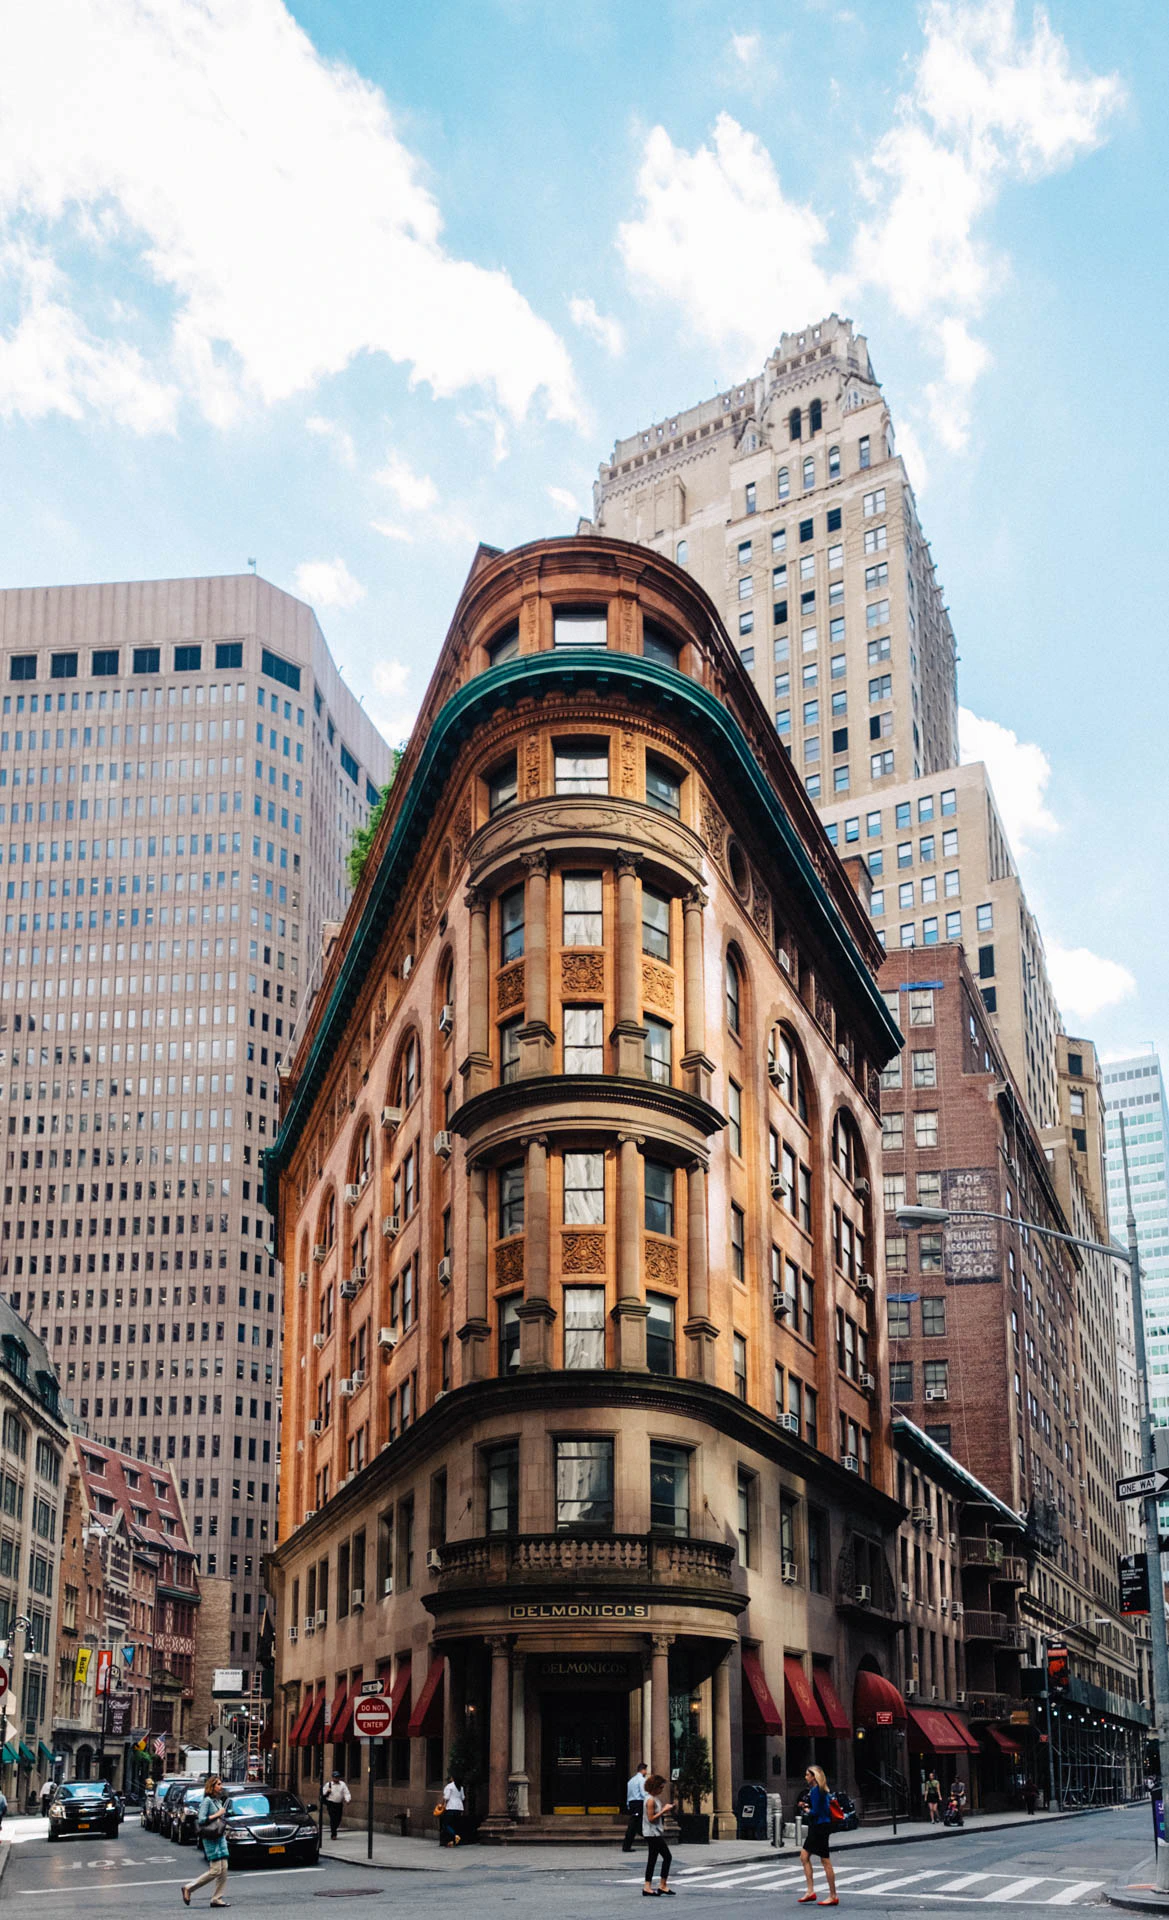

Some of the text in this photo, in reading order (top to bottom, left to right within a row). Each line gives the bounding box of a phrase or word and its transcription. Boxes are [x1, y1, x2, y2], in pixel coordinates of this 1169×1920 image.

[950, 1187, 988, 1198] SPACE
[1121, 1478, 1155, 1494] ONE WAY
[513, 1605, 646, 1617] DELMONICO'S
